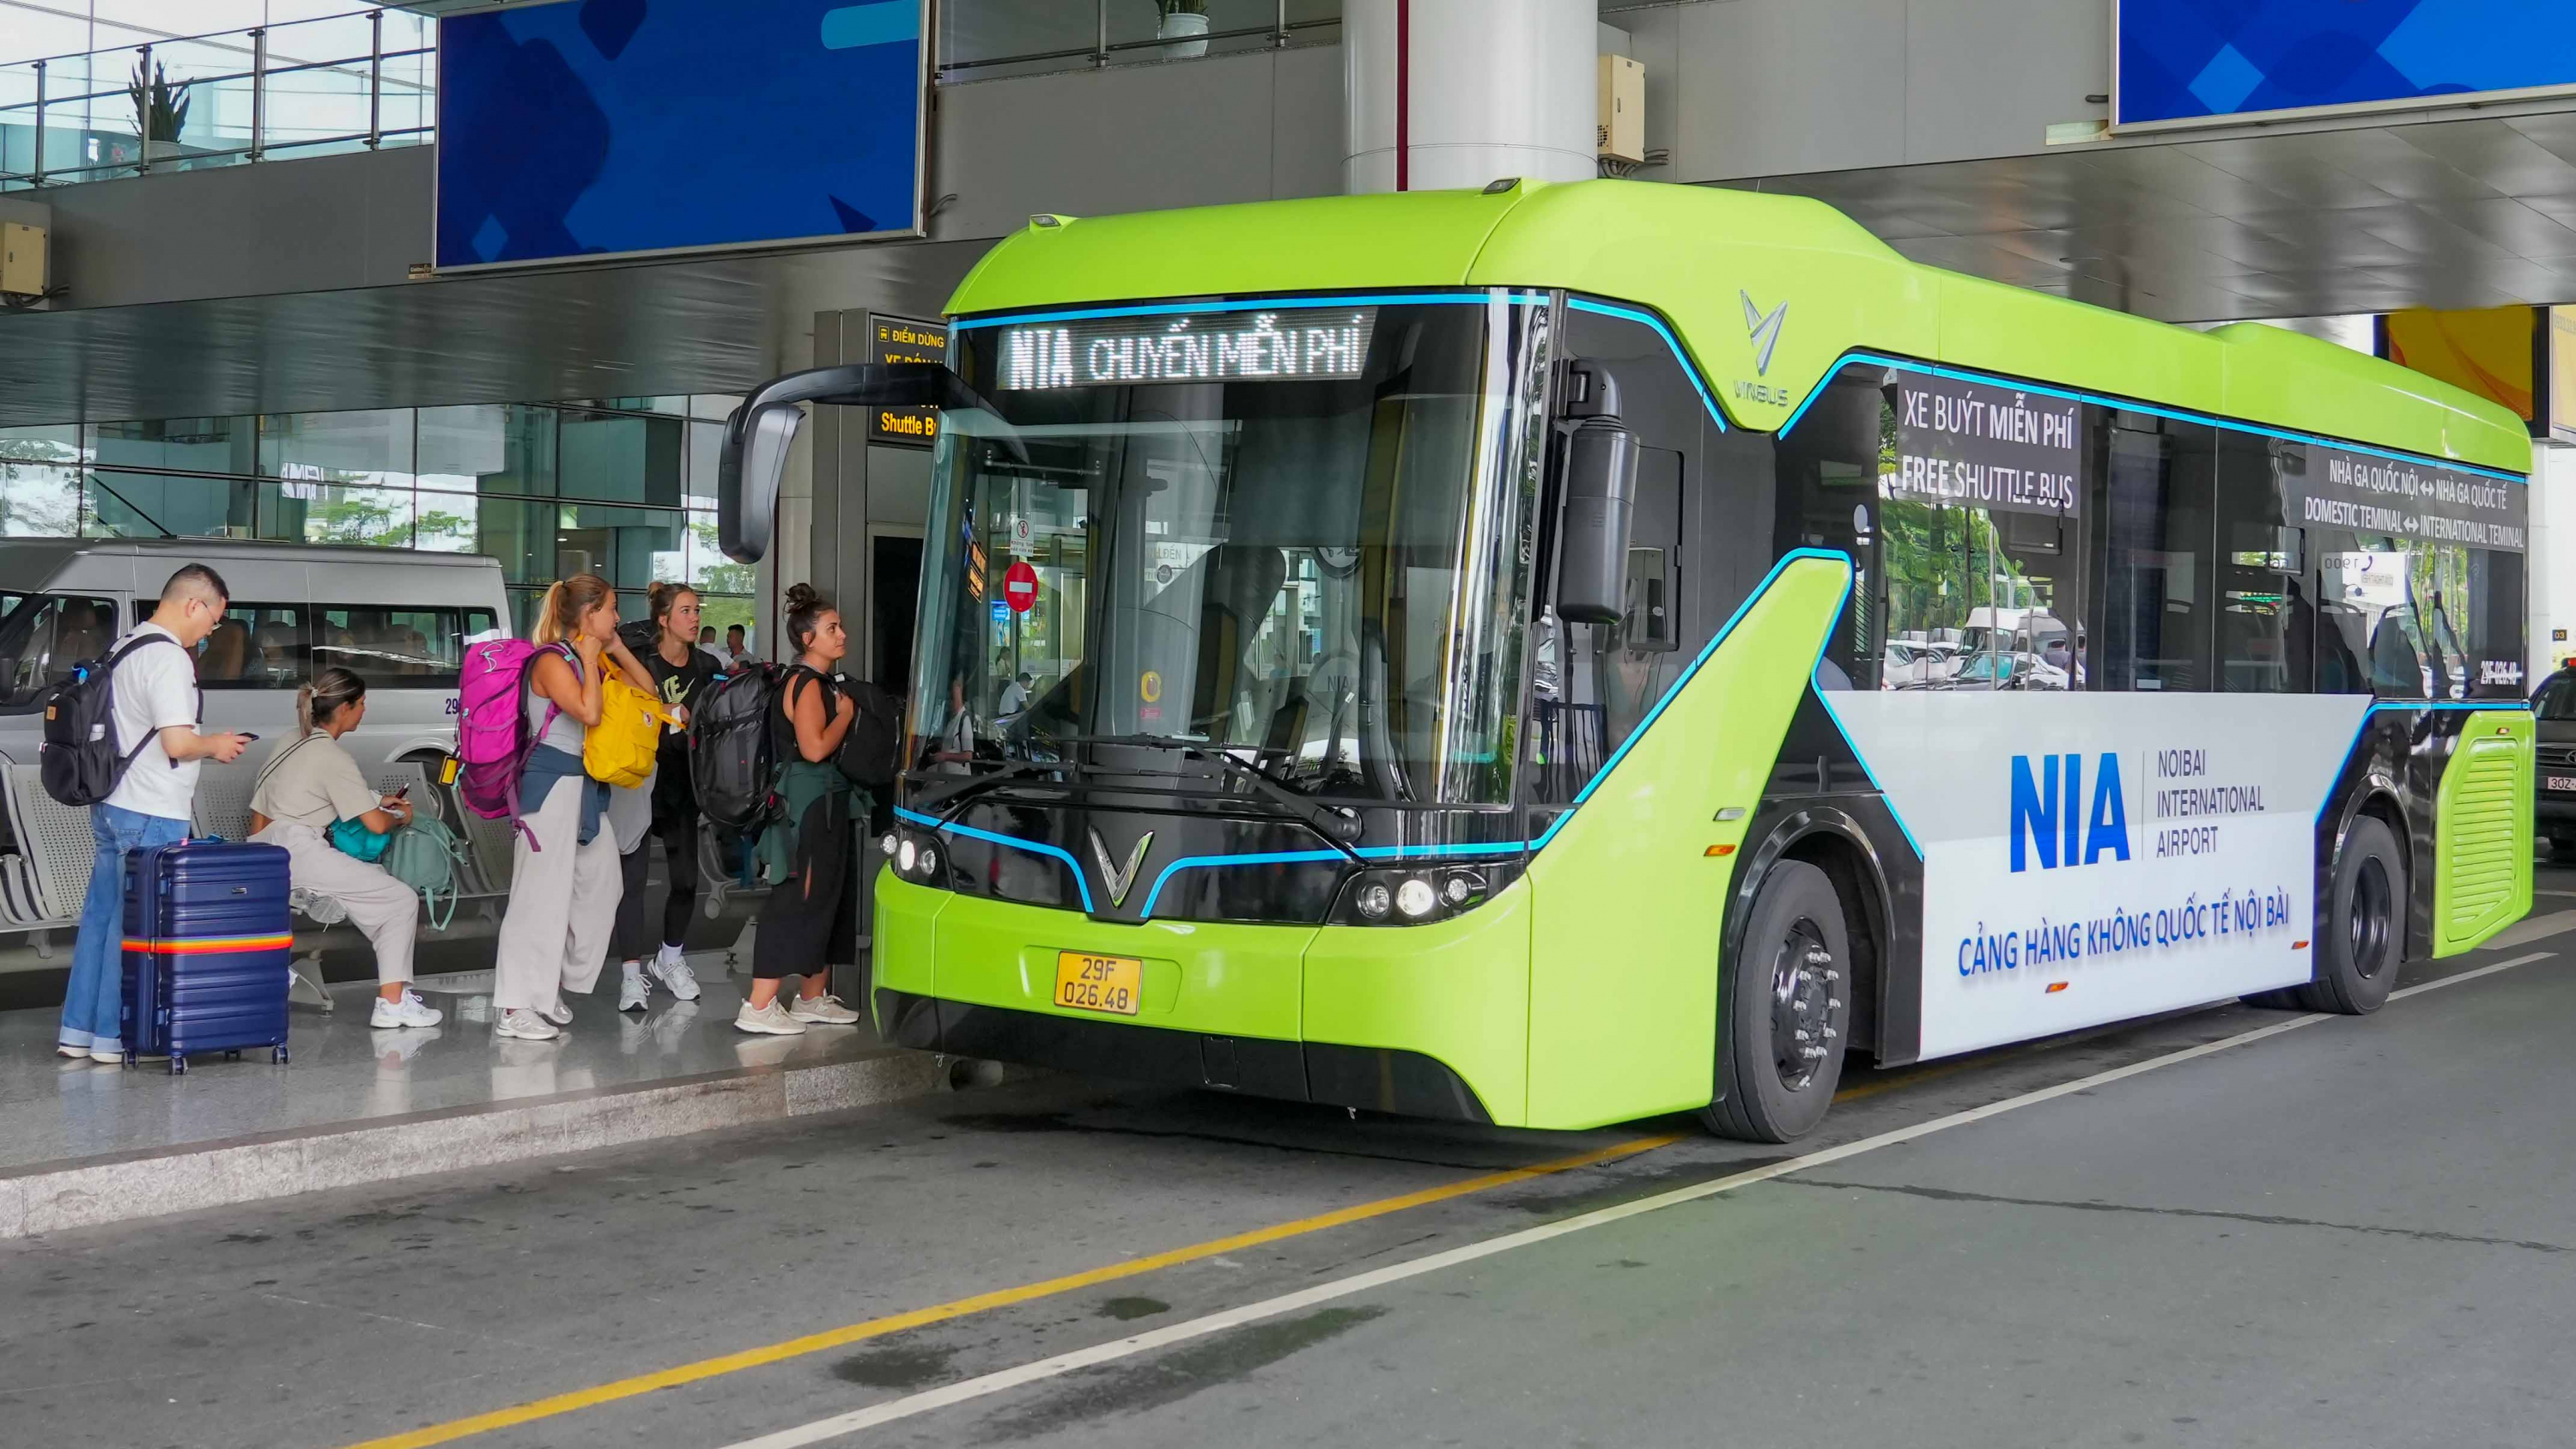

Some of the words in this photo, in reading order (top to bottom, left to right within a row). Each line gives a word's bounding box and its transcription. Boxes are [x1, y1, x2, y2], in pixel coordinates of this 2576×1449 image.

[892, 326, 915, 344] ĐIỂM
[917, 332, 945, 348] DỪNG
[1011, 329, 1073, 390] NIA
[1088, 318, 1209, 380] CHUYẾN
[1218, 314, 1297, 375] MIỄN
[1306, 314, 1364, 374] PHÍ
[1734, 380, 1789, 407] VINBUS
[881, 411, 922, 435] Shuttle
[925, 417, 936, 436] B
[1904, 389, 1929, 429] XE
[1935, 391, 1985, 436] BUÝT
[1989, 393, 2038, 445] MIỄN
[2043, 407, 2075, 449] PHÍ
[1902, 455, 1950, 496] FREE
[1953, 461, 2035, 505] SHUTTLE
[2036, 472, 2073, 509] BUS
[2329, 455, 2353, 485] NHÀ
[2354, 464, 2369, 490] GA
[2371, 461, 2400, 494] QUỐC
[2401, 468, 2419, 501] NỘI
[2435, 475, 2456, 503] NHÀ
[2457, 482, 2470, 506] GA
[2470, 479, 2496, 509] QUỐC
[2496, 483, 2508, 510] TẾ
[2305, 496, 2359, 527] DOMESTIC
[2360, 505, 2403, 533] TEMINAL
[2420, 514, 2488, 545] INTERNATIONAL
[2488, 523, 2524, 548] TEMINAL
[445, 697, 459, 715] 29
[2158, 749, 2205, 778] NOIBAI
[2010, 752, 2130, 873] NIA
[2157, 786, 2264, 818] INTERNATIONAL
[2156, 826, 2218, 858] AIRPORT
[1958, 921, 2018, 977] CẢNG
[2025, 916, 2080, 966] HÀNG
[2087, 905, 2151, 956] KHÔNG
[2155, 892, 2207, 948] QUỐC
[2211, 887, 2232, 936] TẾ
[2233, 888, 2262, 937] NỘI
[2266, 885, 2290, 927] BÀI
[1080, 958, 1117, 982] 29F
[1064, 982, 1129, 1010] 026.48
